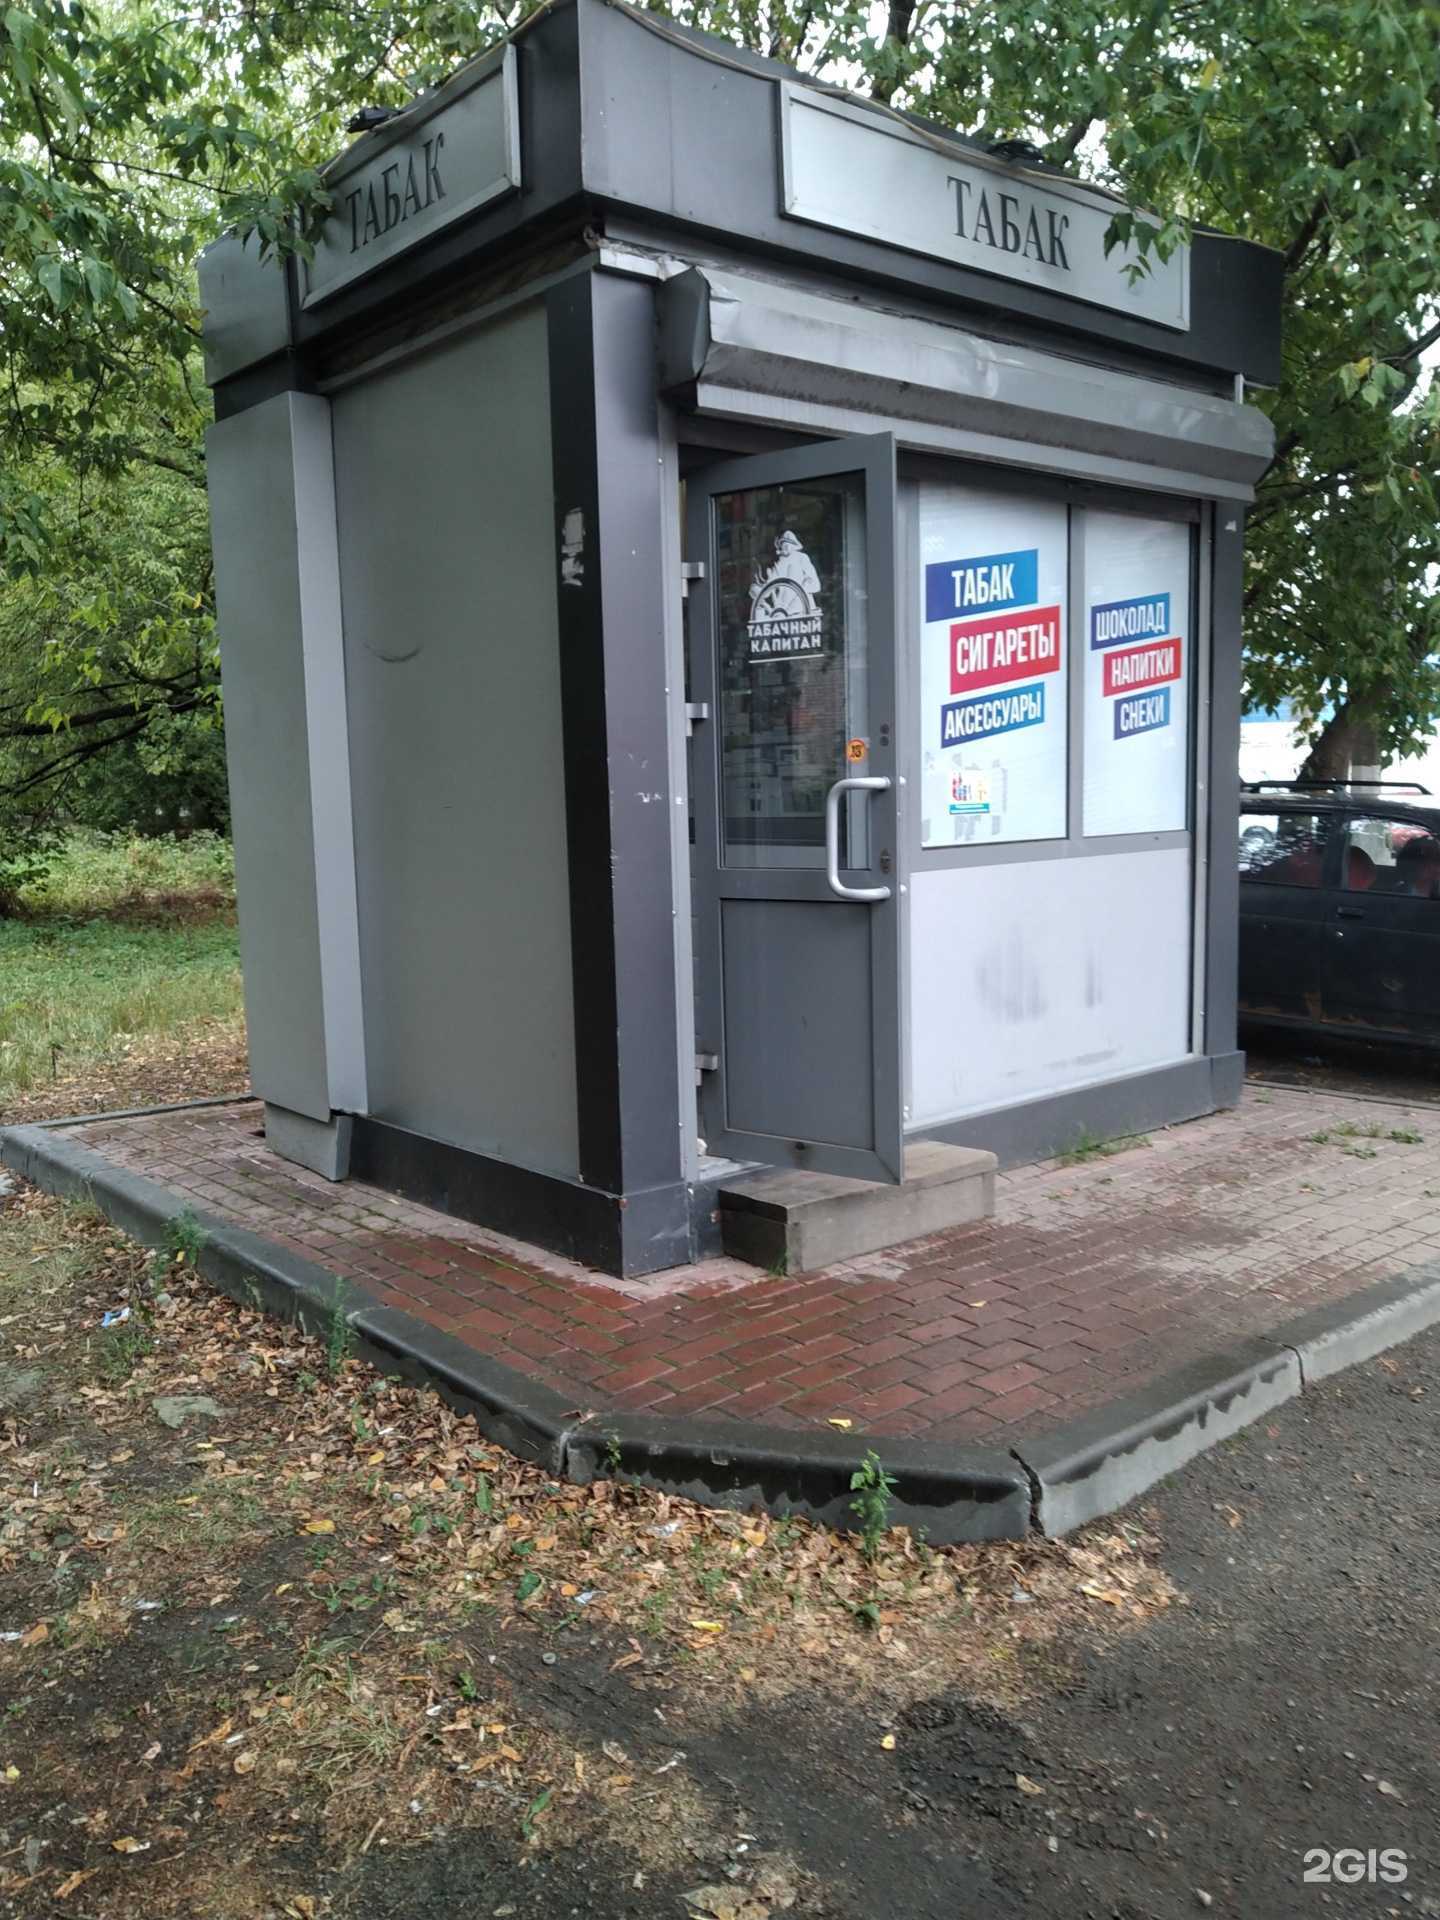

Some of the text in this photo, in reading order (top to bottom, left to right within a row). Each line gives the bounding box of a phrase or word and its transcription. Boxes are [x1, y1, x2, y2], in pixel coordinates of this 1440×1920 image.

[345, 131, 446, 254] ТАБАК
[946, 175, 1070, 271] ТАБАК
[951, 563, 1015, 608] ТАБАК
[747, 617, 822, 638] ТАБАЧНЫЙ
[751, 634, 821, 653] КАПИТАН
[1096, 602, 1165, 642] ШОКОЛАД
[956, 622, 1056, 676] СИГАРЕТЫ
[1111, 646, 1174, 688] НАПИТКИ
[944, 690, 1041, 740] АКСЕССУАРЫ
[1120, 694, 1164, 732] СНЕКИ
